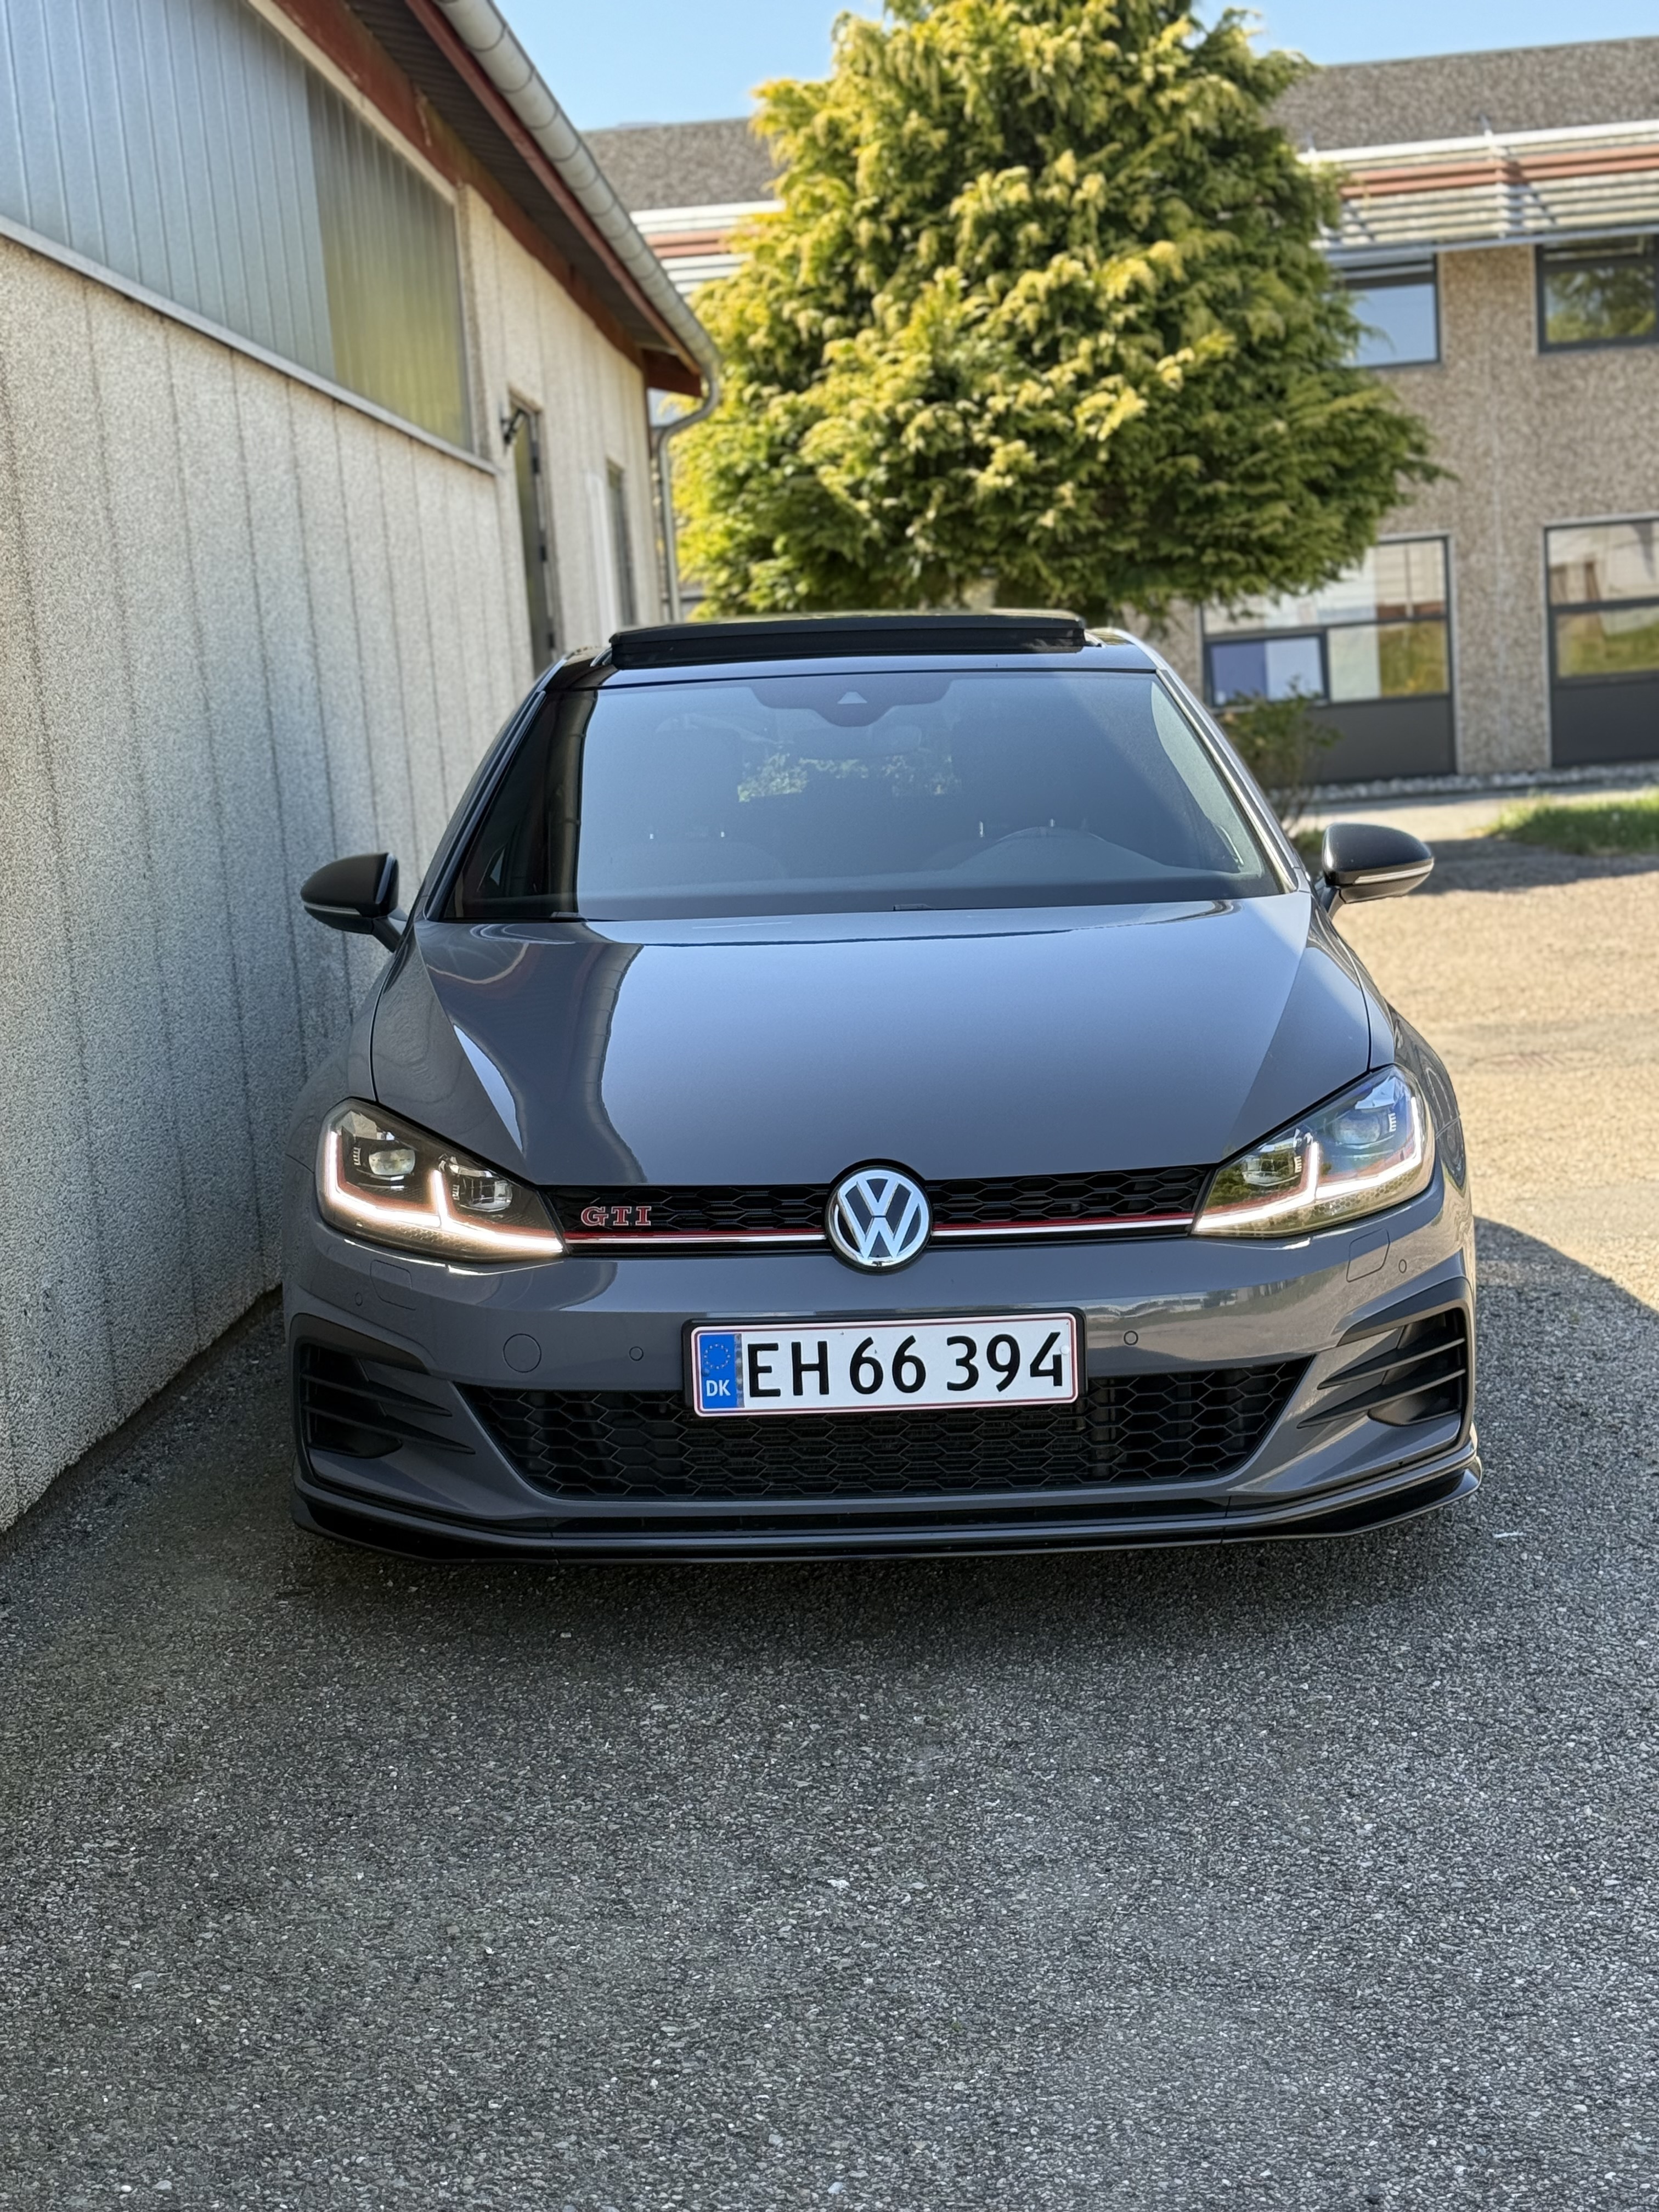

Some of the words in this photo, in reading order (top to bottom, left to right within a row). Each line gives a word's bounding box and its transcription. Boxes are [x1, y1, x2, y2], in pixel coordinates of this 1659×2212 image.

[580, 1206, 652, 1227] GTI
[747, 1340, 830, 1397] EH
[849, 1335, 927, 1395] 66
[946, 1331, 1063, 1393] 394
[706, 1379, 731, 1397] DK
